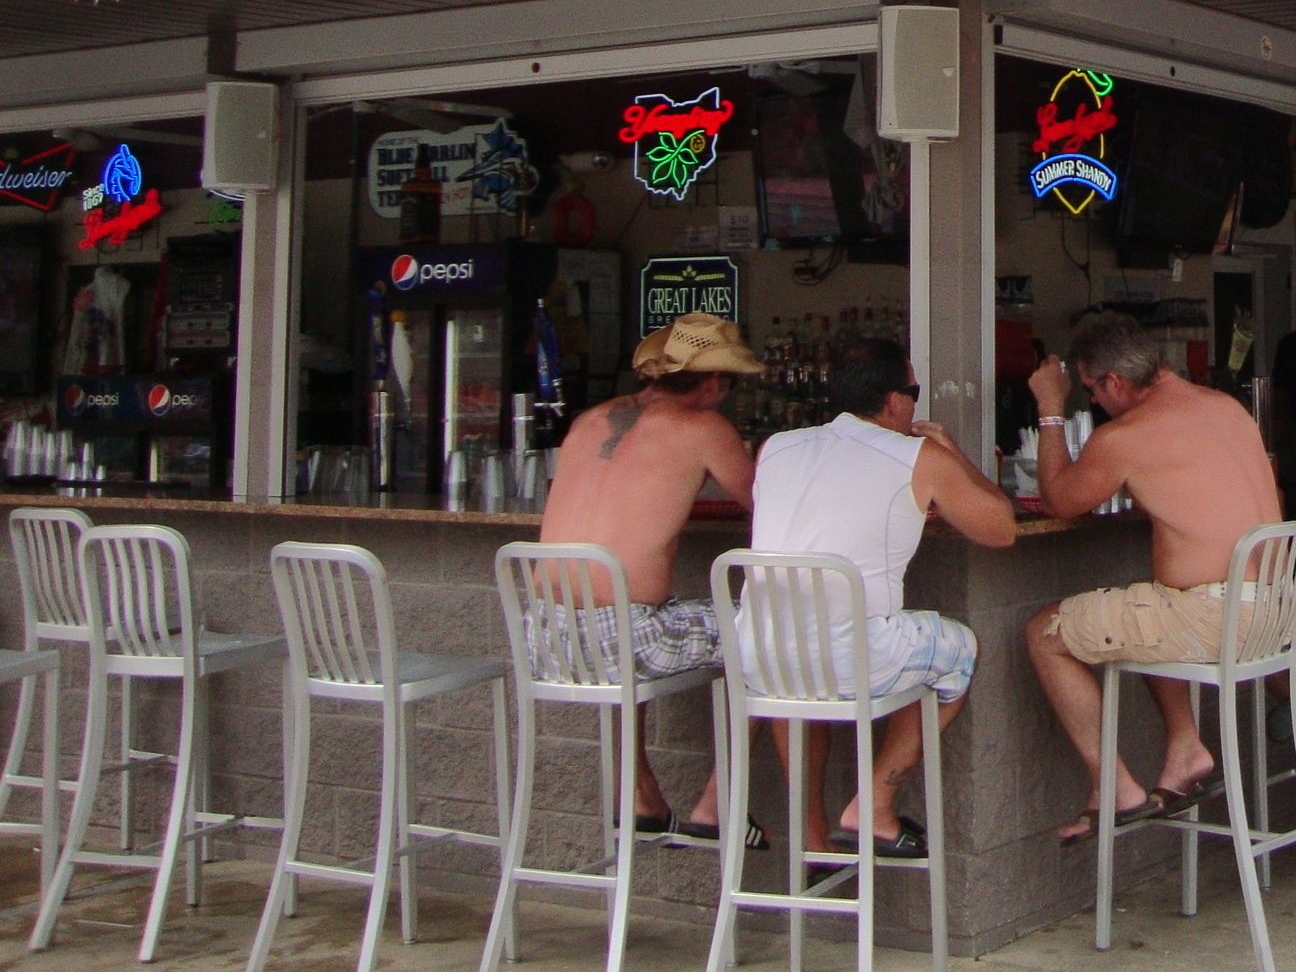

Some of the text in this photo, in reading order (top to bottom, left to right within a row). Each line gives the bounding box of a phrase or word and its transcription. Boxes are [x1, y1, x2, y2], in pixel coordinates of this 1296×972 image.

[377, 163, 449, 187] SOFTLL
[1035, 159, 1112, 192] SUMMER SHANDY
[419, 259, 474, 283] pepsi
[647, 285, 732, 315] GREAT LAKES
[87, 391, 205, 409] pepsi pep
